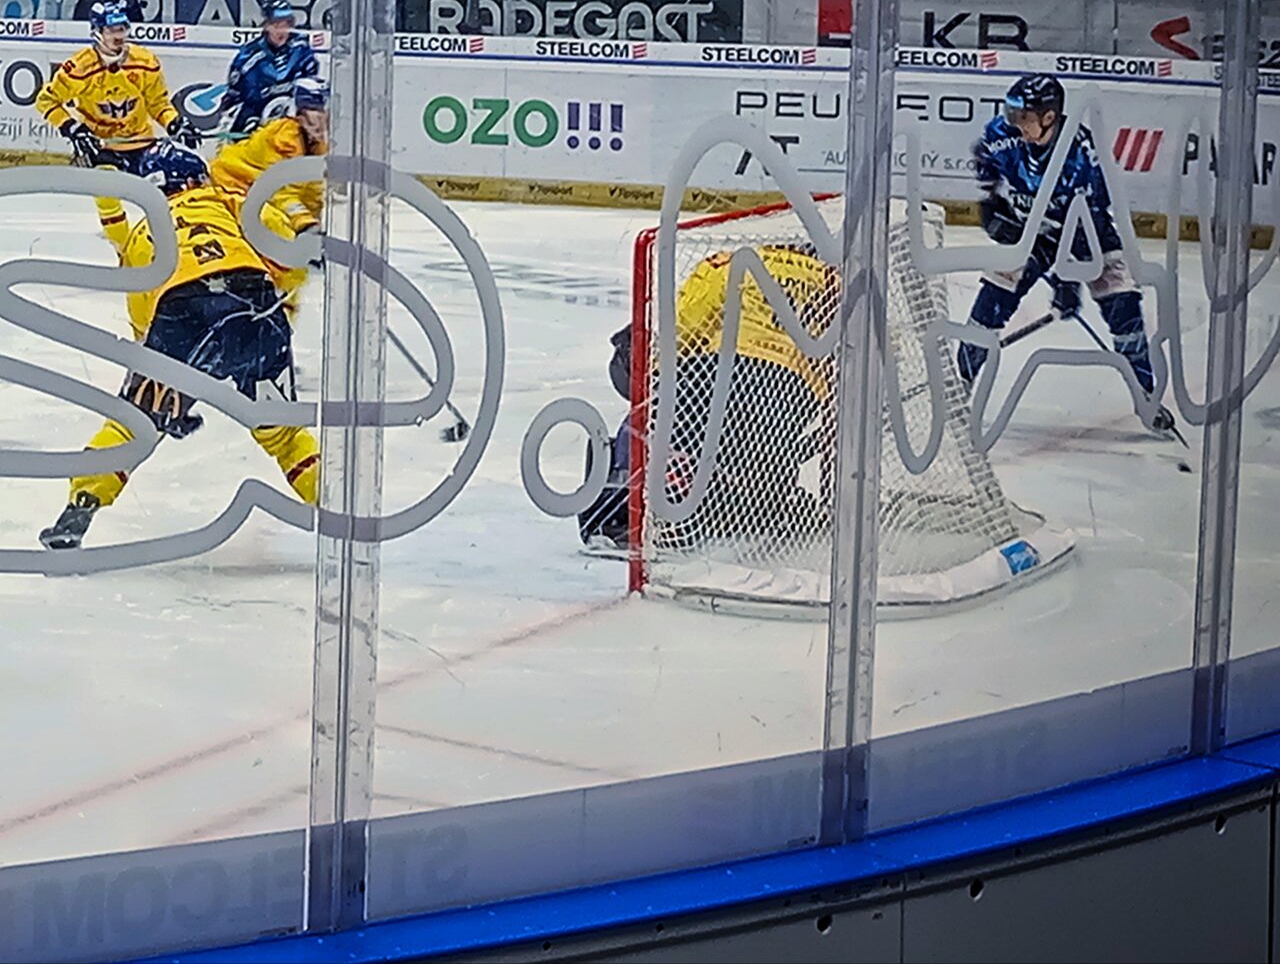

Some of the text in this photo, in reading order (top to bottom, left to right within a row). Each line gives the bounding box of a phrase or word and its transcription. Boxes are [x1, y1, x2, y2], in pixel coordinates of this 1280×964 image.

[393, 35, 468, 53] TEELCOM
[535, 40, 631, 59] STEELCOM
[701, 46, 801, 65] STEELCOM
[1055, 55, 1156, 77] STEELCOM
[735, 90, 1007, 123] PEUEOT
[422, 95, 625, 152] OZO!!!
